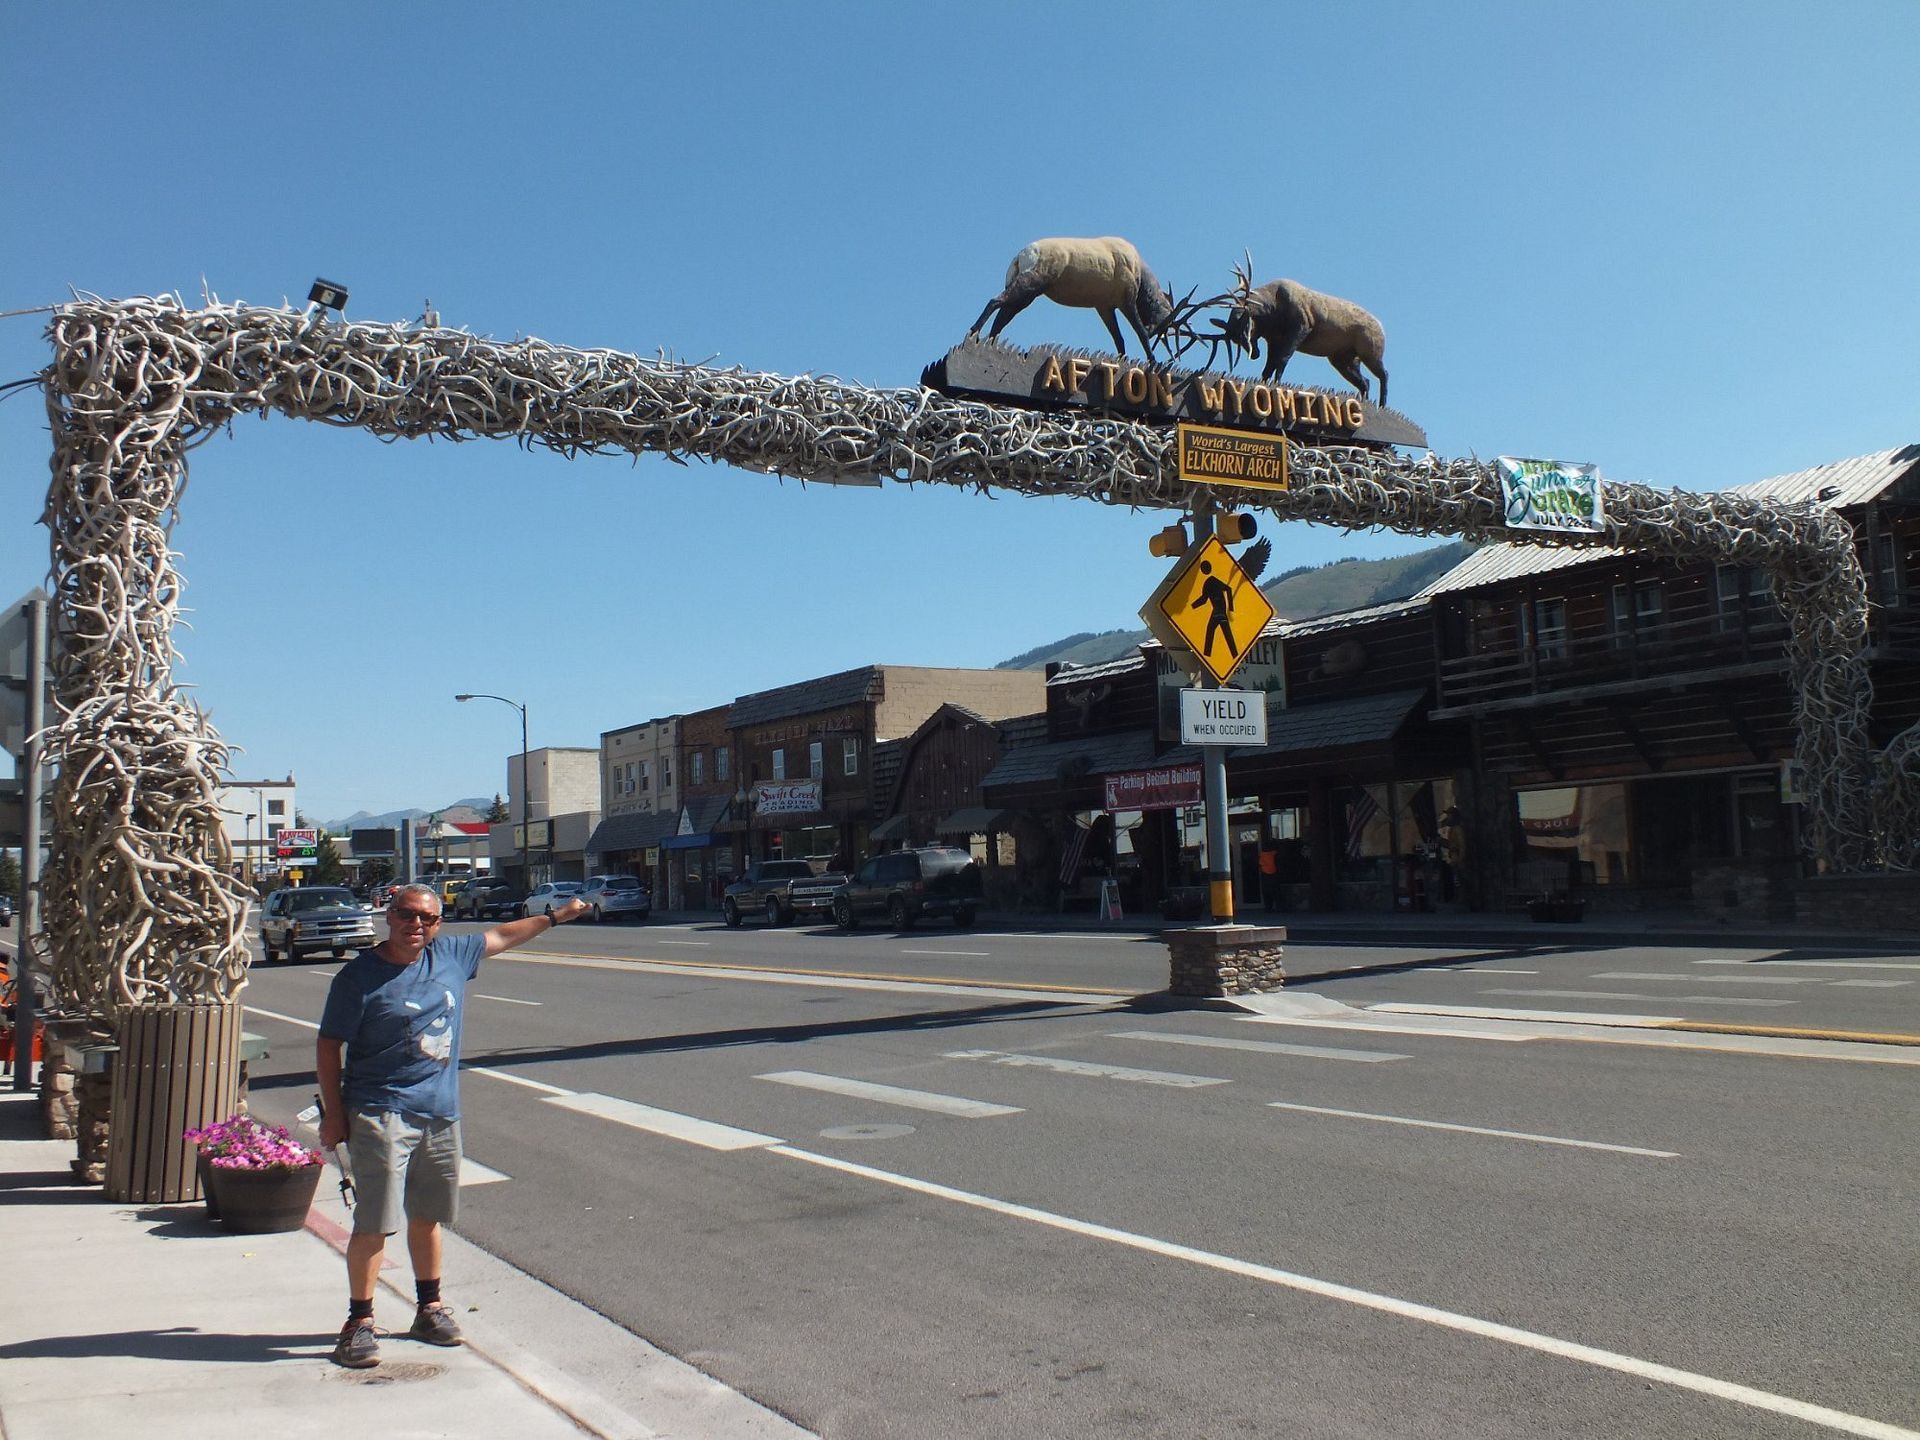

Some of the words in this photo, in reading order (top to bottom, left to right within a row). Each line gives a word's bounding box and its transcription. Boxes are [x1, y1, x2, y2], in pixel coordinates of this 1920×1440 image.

[1042, 354, 1174, 408] AFTON
[1194, 375, 1364, 430] WYOMING
[1191, 435, 1232, 450] World's
[1235, 441, 1275, 456] Largest
[1186, 450, 1244, 476] ELKHORN
[1246, 457, 1280, 479] ARCH
[1533, 515, 1562, 527] JULY
[1202, 699, 1246, 719] YIELD
[1193, 724, 1216, 735] WHEN
[1219, 724, 1257, 736] OCCUPIED
[1120, 775, 1145, 790] Parking
[1146, 770, 1170, 787] Behind
[1171, 767, 1200, 785] Building
[760, 788, 787, 803] Swift
[789, 787, 817, 799] Creek
